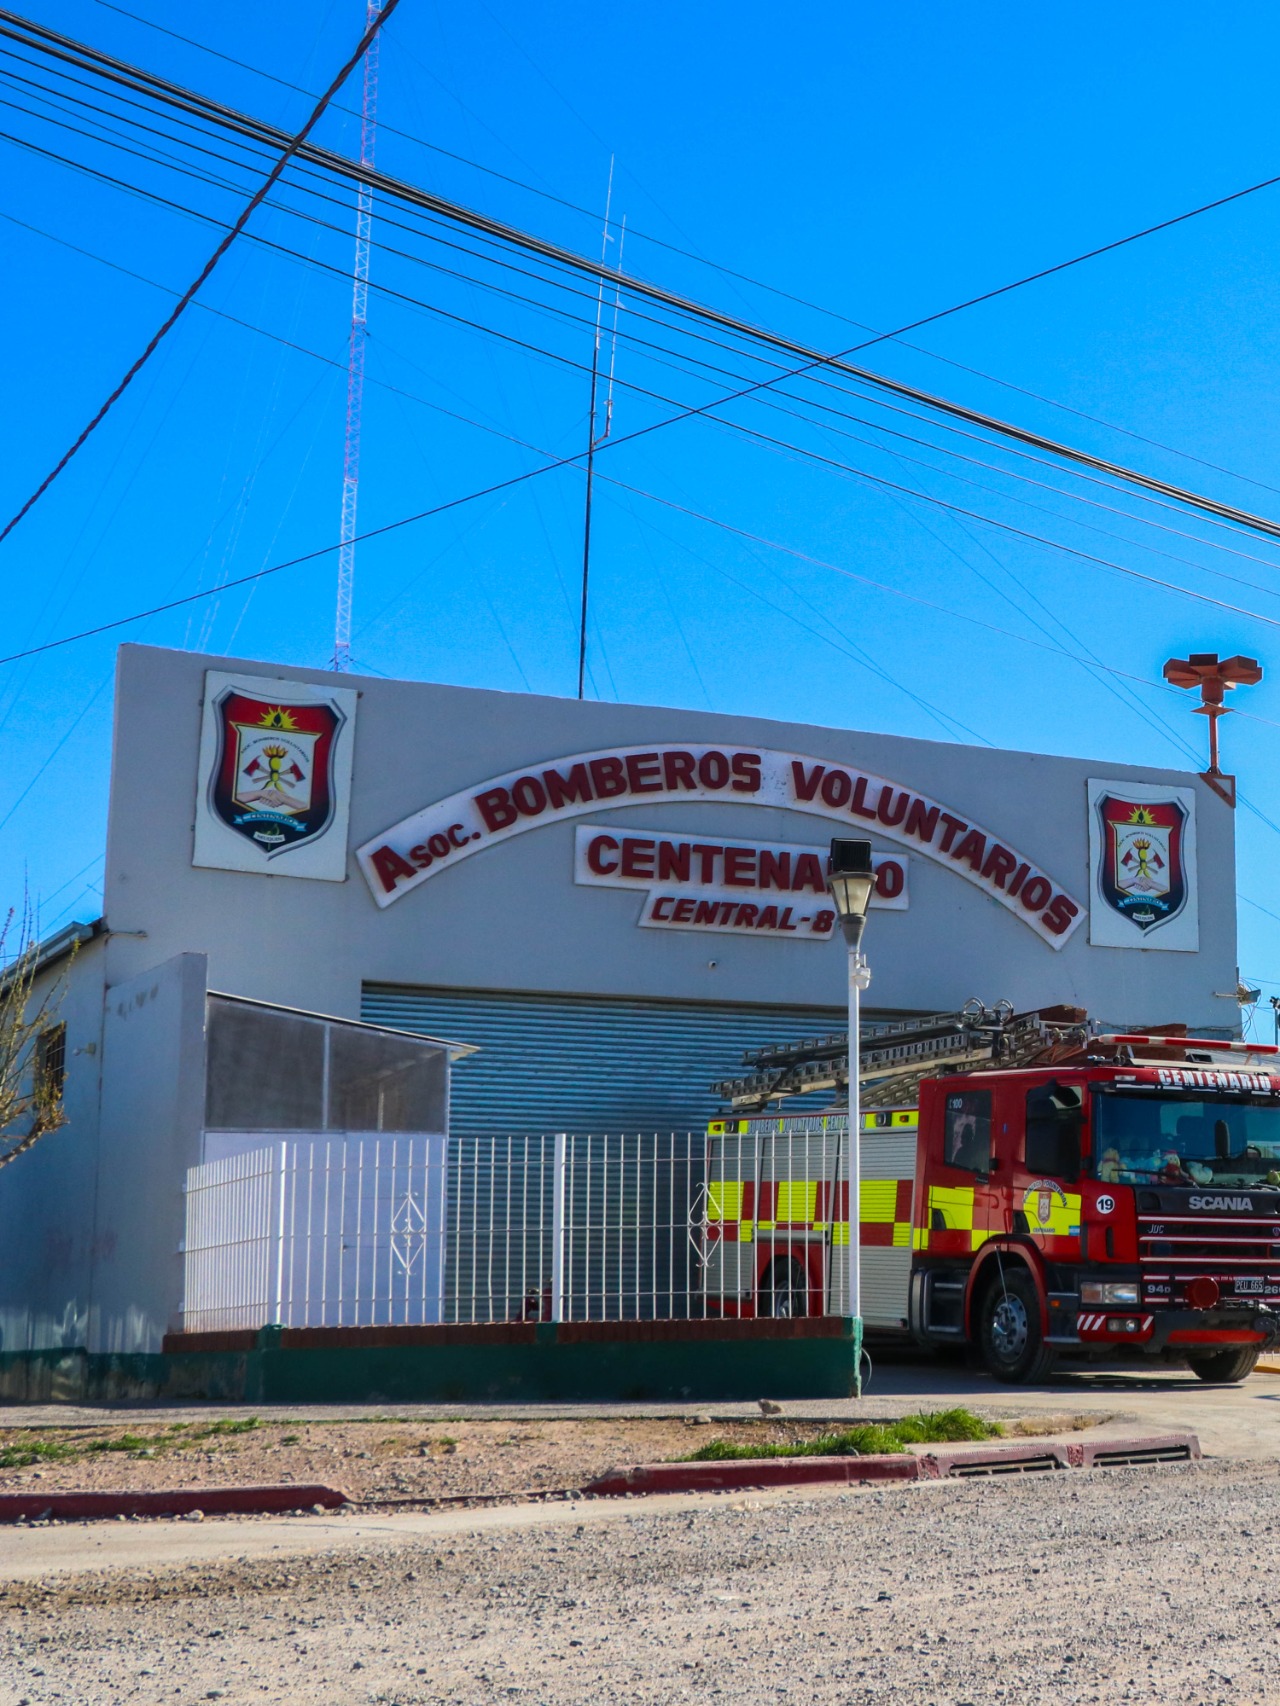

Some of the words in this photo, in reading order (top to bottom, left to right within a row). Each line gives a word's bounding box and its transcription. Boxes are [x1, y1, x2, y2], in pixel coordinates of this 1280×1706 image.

[473, 750, 761, 834] BOMBEROS
[791, 760, 1079, 935] VOLUNTARIOS
[587, 835, 904, 898] CENTENAO
[1158, 1069, 1271, 1091] CENTENARIO
[1097, 1198, 1113, 1210] 19
[1188, 1196, 1253, 1211] SCANIA
[1235, 1281, 1248, 1290] PEU
[1250, 1281, 1263, 1290] 665
